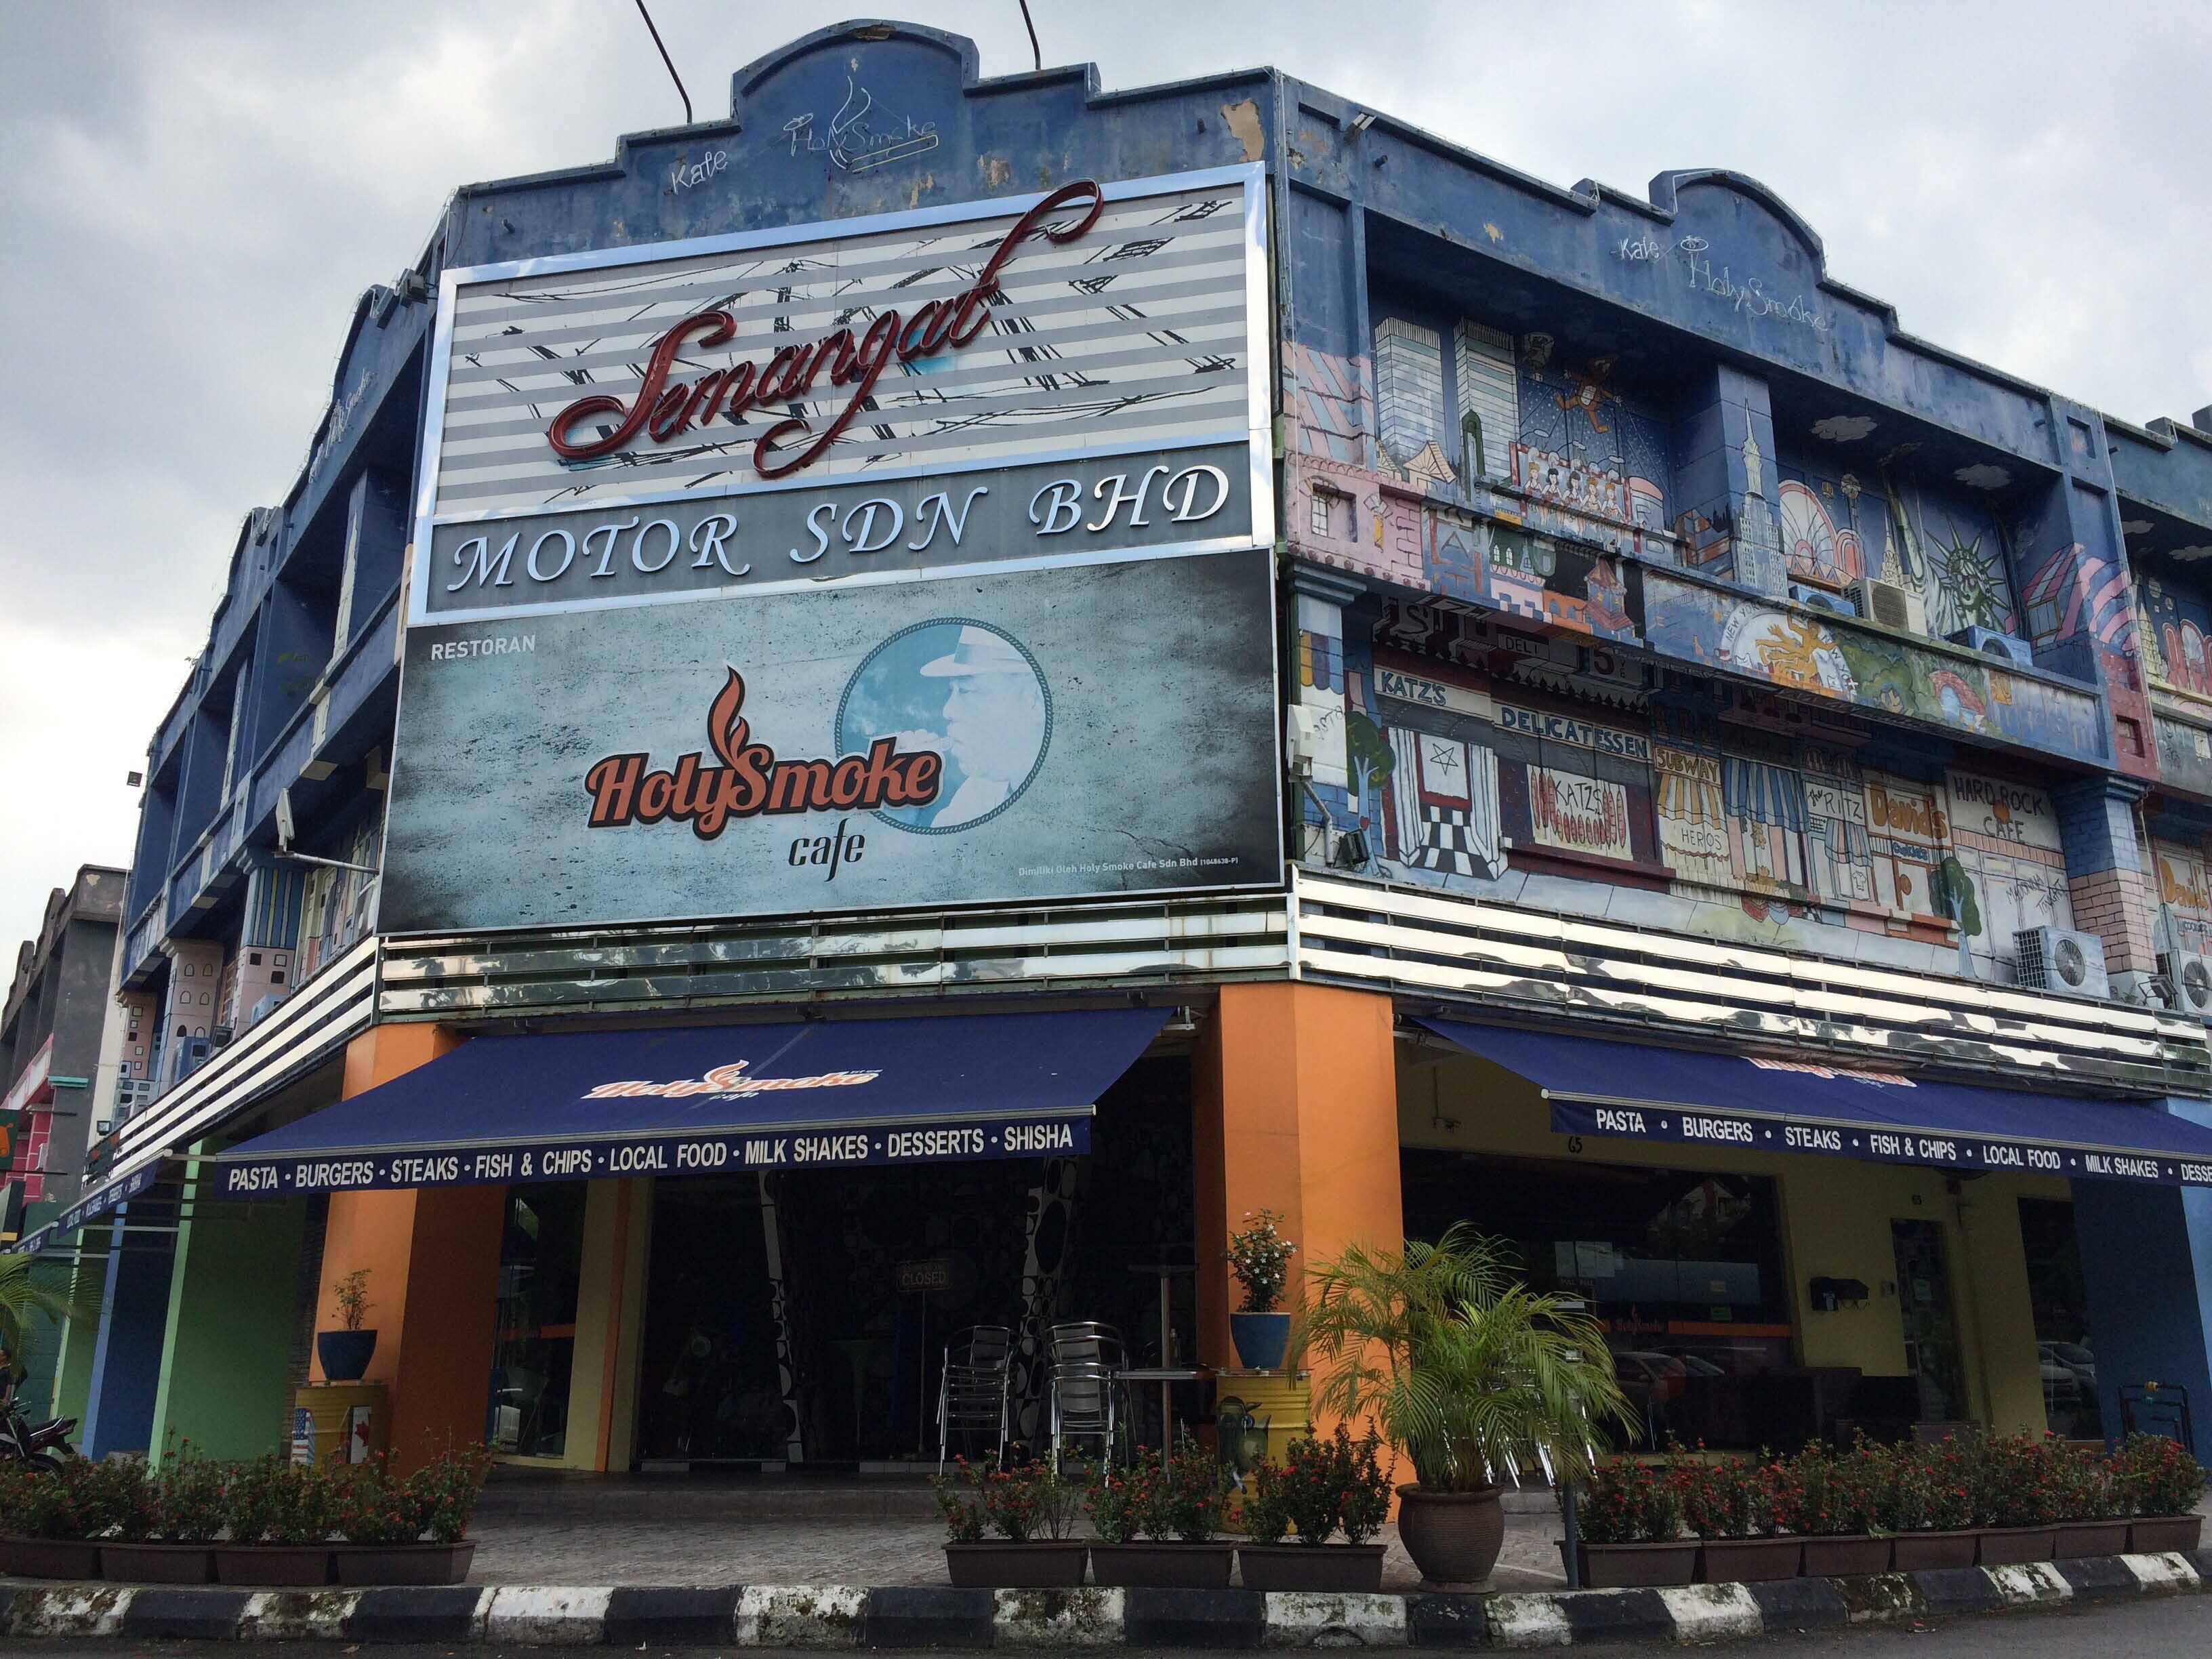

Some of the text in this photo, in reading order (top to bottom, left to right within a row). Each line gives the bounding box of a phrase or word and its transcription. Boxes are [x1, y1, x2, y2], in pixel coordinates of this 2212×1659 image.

[547, 178, 1105, 478] Semangat
[447, 464, 1230, 592] MOTOR SDN BHD
[430, 634, 537, 661] RESTORAN
[1380, 670, 1650, 759] KATZ'S DELICATESSEN
[1657, 747, 1719, 783] SUBWAY
[1823, 792, 1864, 820] RITZ
[1870, 781, 1948, 840] David's
[1954, 776, 2045, 816] HARD ROCK
[788, 817, 867, 882] cafe
[1983, 816, 2026, 844] CAFE
[1019, 865, 1054, 876] Dimiliki
[1056, 865, 1078, 874] Oleh
[1079, 863, 1101, 874] Holy
[1102, 861, 1134, 872] Smoke
[1136, 859, 1158, 870] Cafe
[1158, 858, 1178, 869] Sdn
[1179, 857, 1199, 867] Bhd
[228, 1122, 1074, 1191] PASTA BURGERS STEAKS FISH & CHIPS LOCAL FOOD MILK SHAKES DESSERTS SHISHA
[1595, 1109, 1647, 1134] PASTA
[1682, 1116, 1754, 1143] BURGERS
[1784, 1125, 1842, 1151] STEAKS
[1870, 1134, 1901, 1156] FISH
[1904, 1136, 1915, 1158] &
[1919, 1139, 1957, 1162] CHIPS
[1982, 1145, 2025, 1167] LOCAL
[2027, 1149, 2062, 1170] FOOD
[2085, 1155, 2114, 1175] MILK
[2114, 1158, 2160, 1179] SHAKES
[901, 1269, 947, 1286] CLOSED
